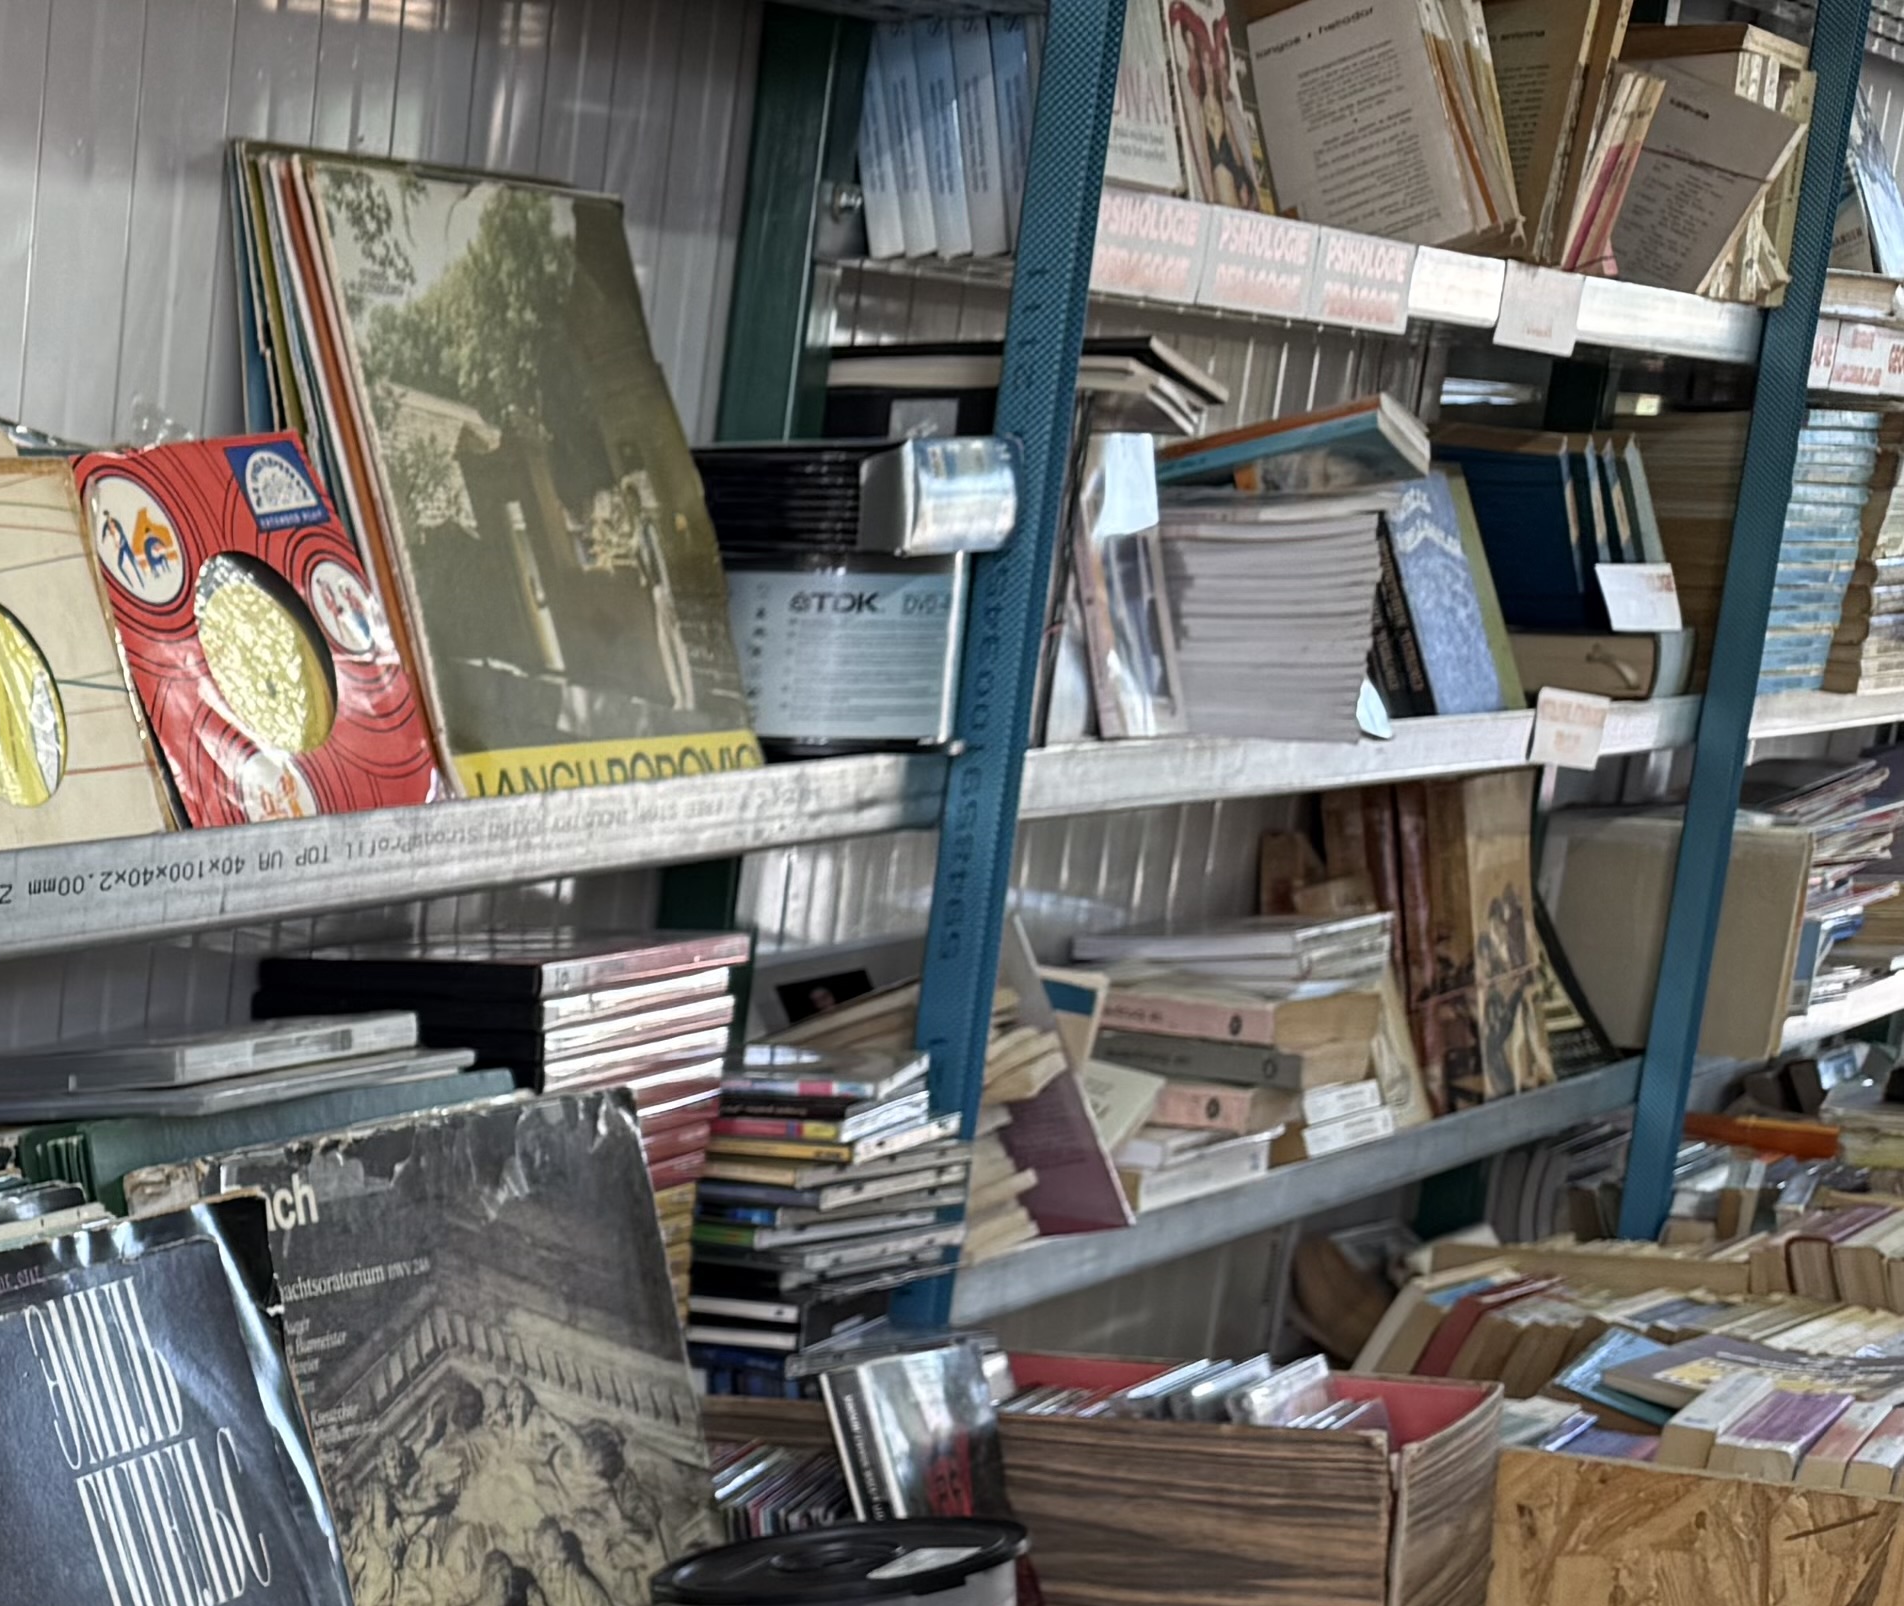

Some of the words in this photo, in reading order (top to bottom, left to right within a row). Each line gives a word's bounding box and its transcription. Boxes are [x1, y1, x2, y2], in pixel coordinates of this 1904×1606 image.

[812, 591, 878, 615] TDK
[258, 849, 284, 871] UA
[295, 844, 331, 866] TOP
[267, 1172, 319, 1232] ch
[22, 1277, 182, 1471] ЭМИЛЬ
